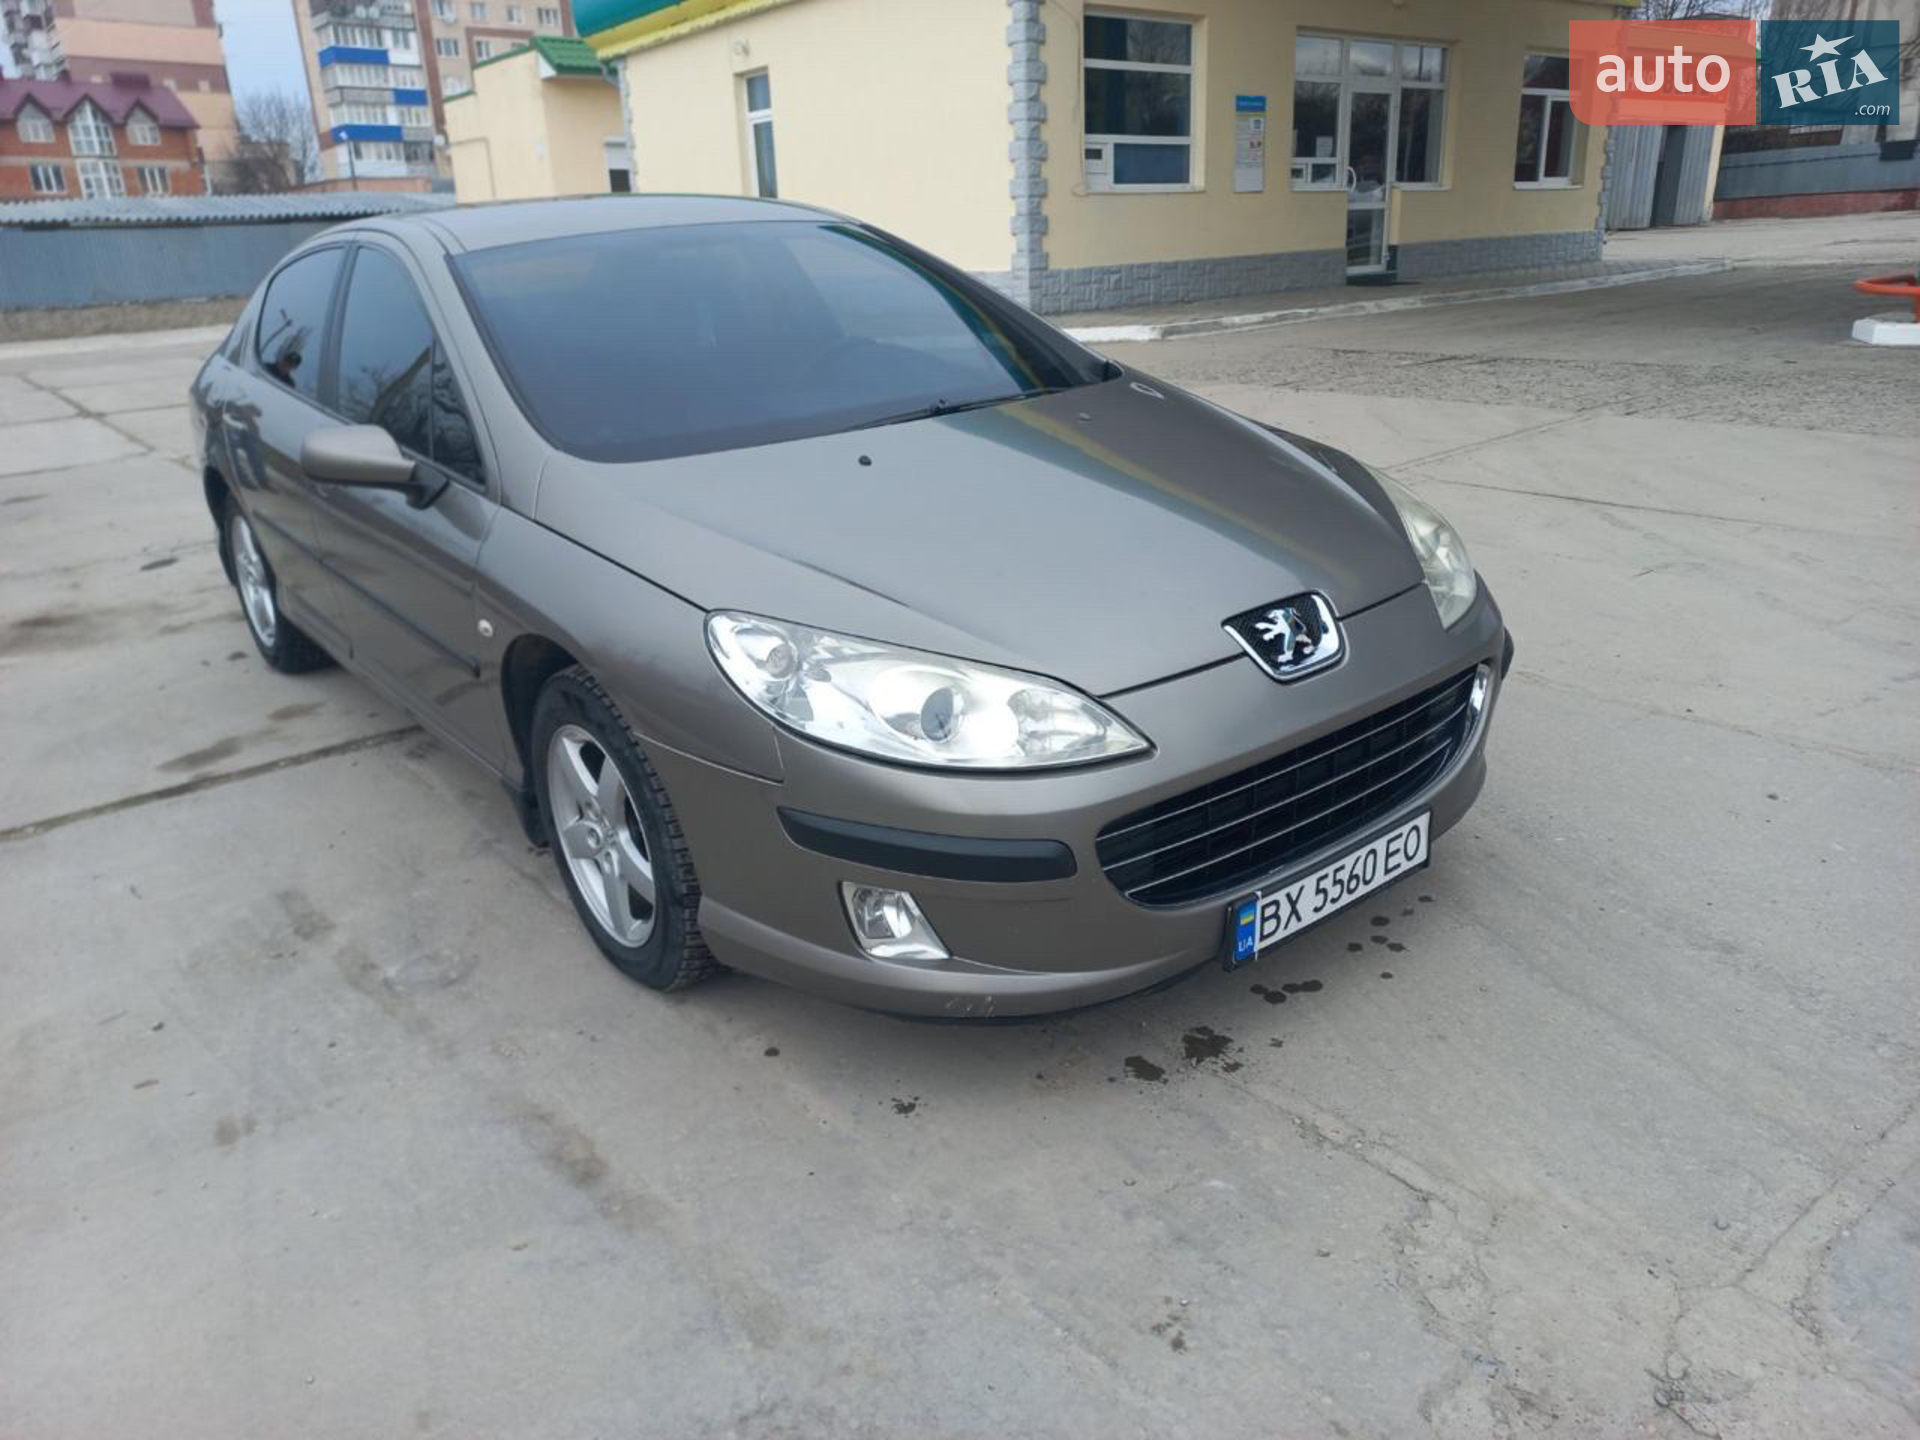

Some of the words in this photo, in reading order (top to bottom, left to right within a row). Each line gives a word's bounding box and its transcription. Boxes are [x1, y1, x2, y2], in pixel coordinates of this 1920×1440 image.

[1260, 885, 1304, 942] BX
[1312, 848, 1378, 914] 5560
[1384, 824, 1421, 876] EO
[1238, 935, 1254, 952] UA
